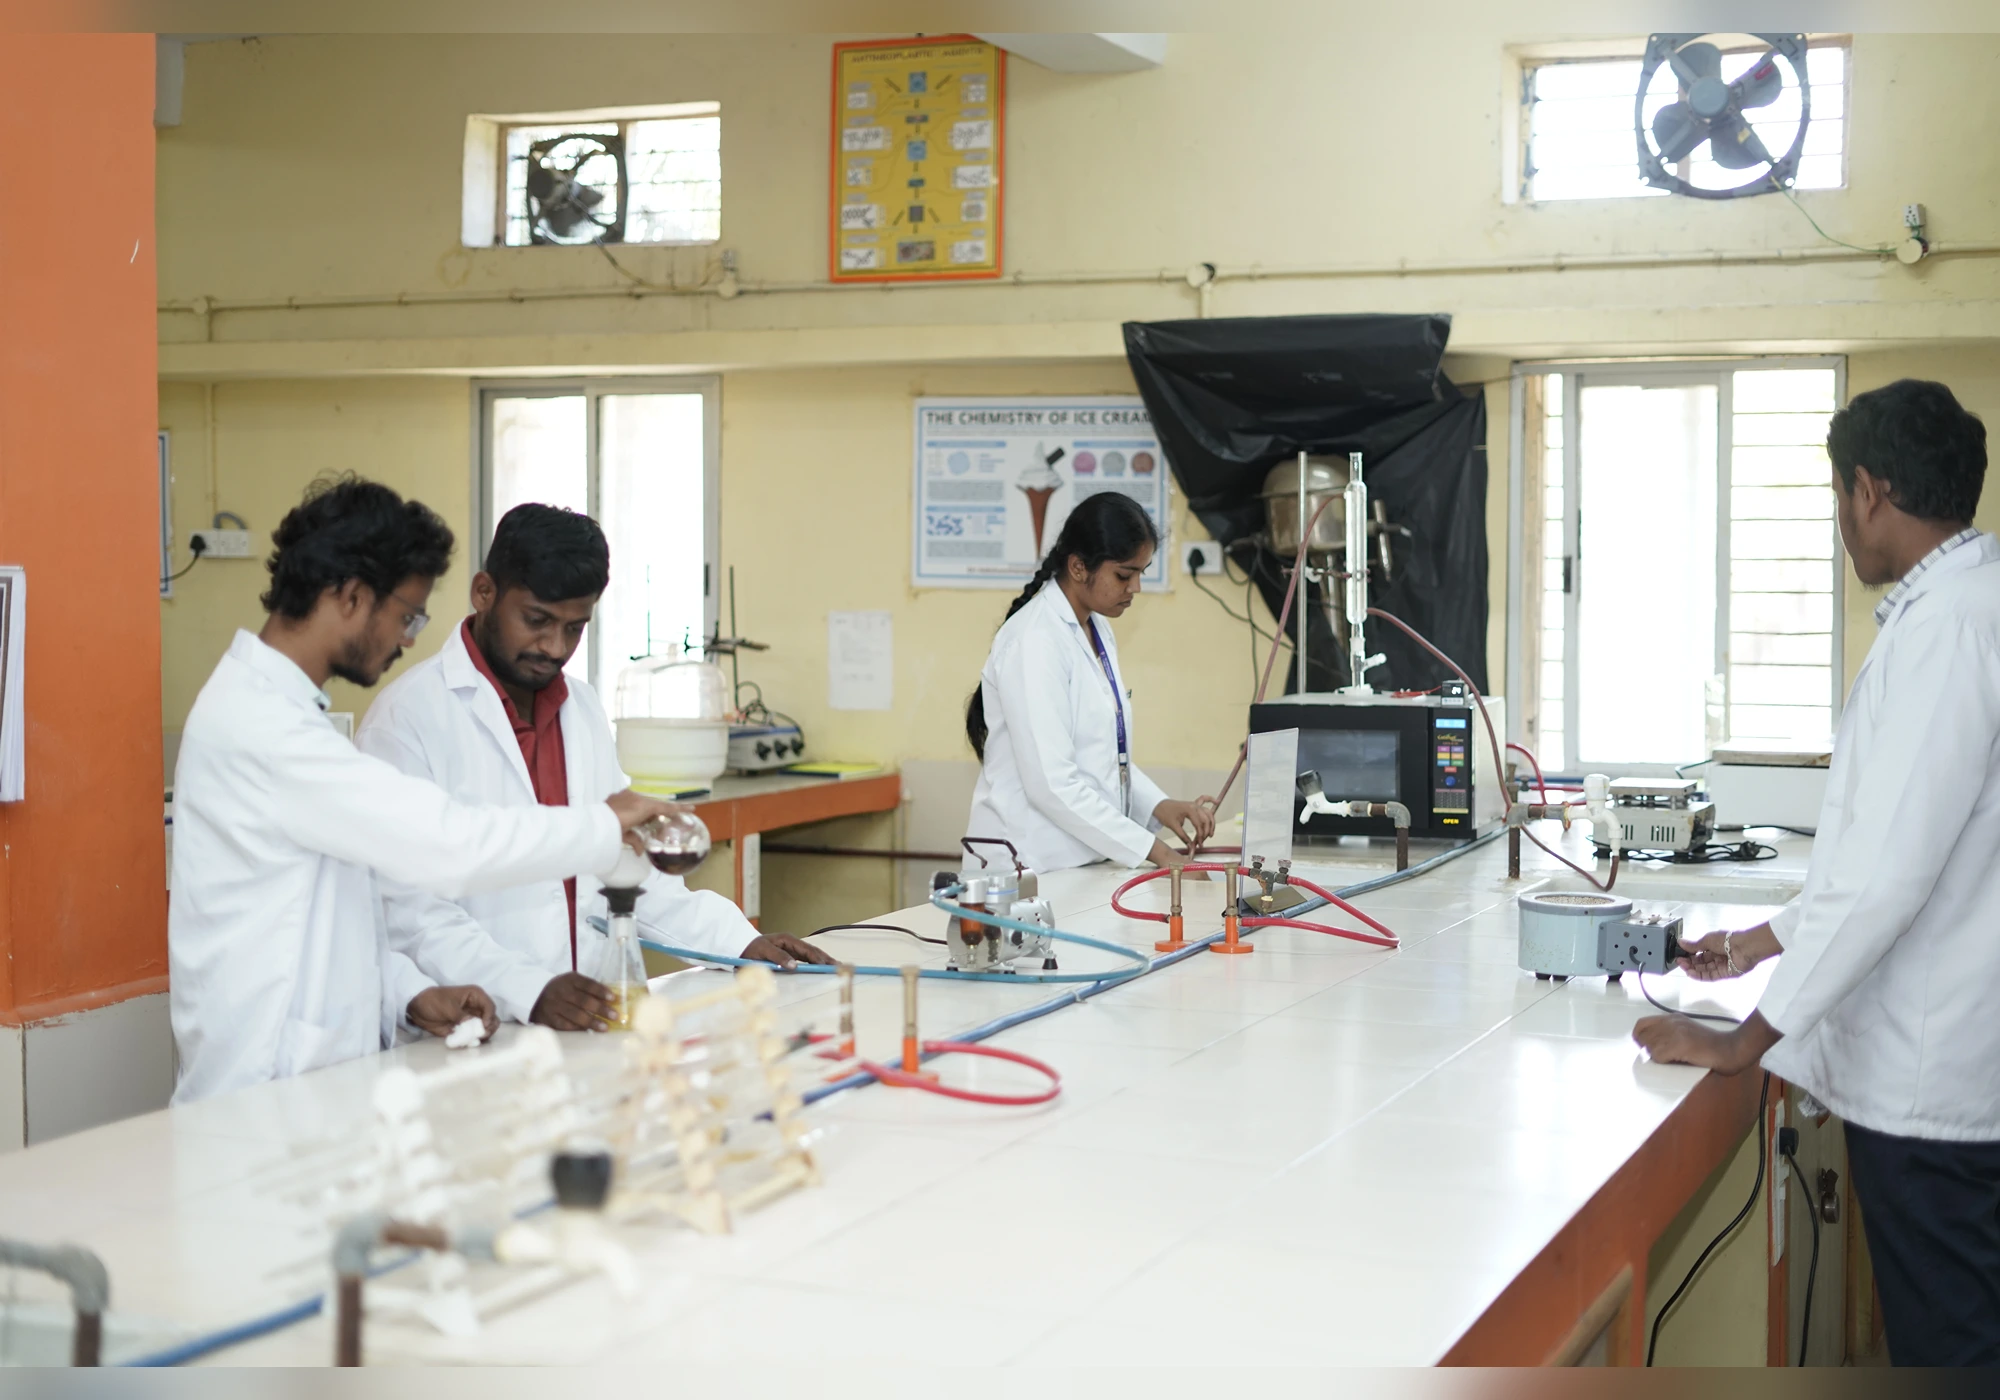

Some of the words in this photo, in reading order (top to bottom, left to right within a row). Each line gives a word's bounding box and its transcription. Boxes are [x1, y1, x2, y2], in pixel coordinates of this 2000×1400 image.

[927, 411, 953, 425] THE
[958, 411, 1044, 425] CHEMISTRY
[1048, 411, 1067, 425] OF
[1073, 411, 1096, 425] ICE
